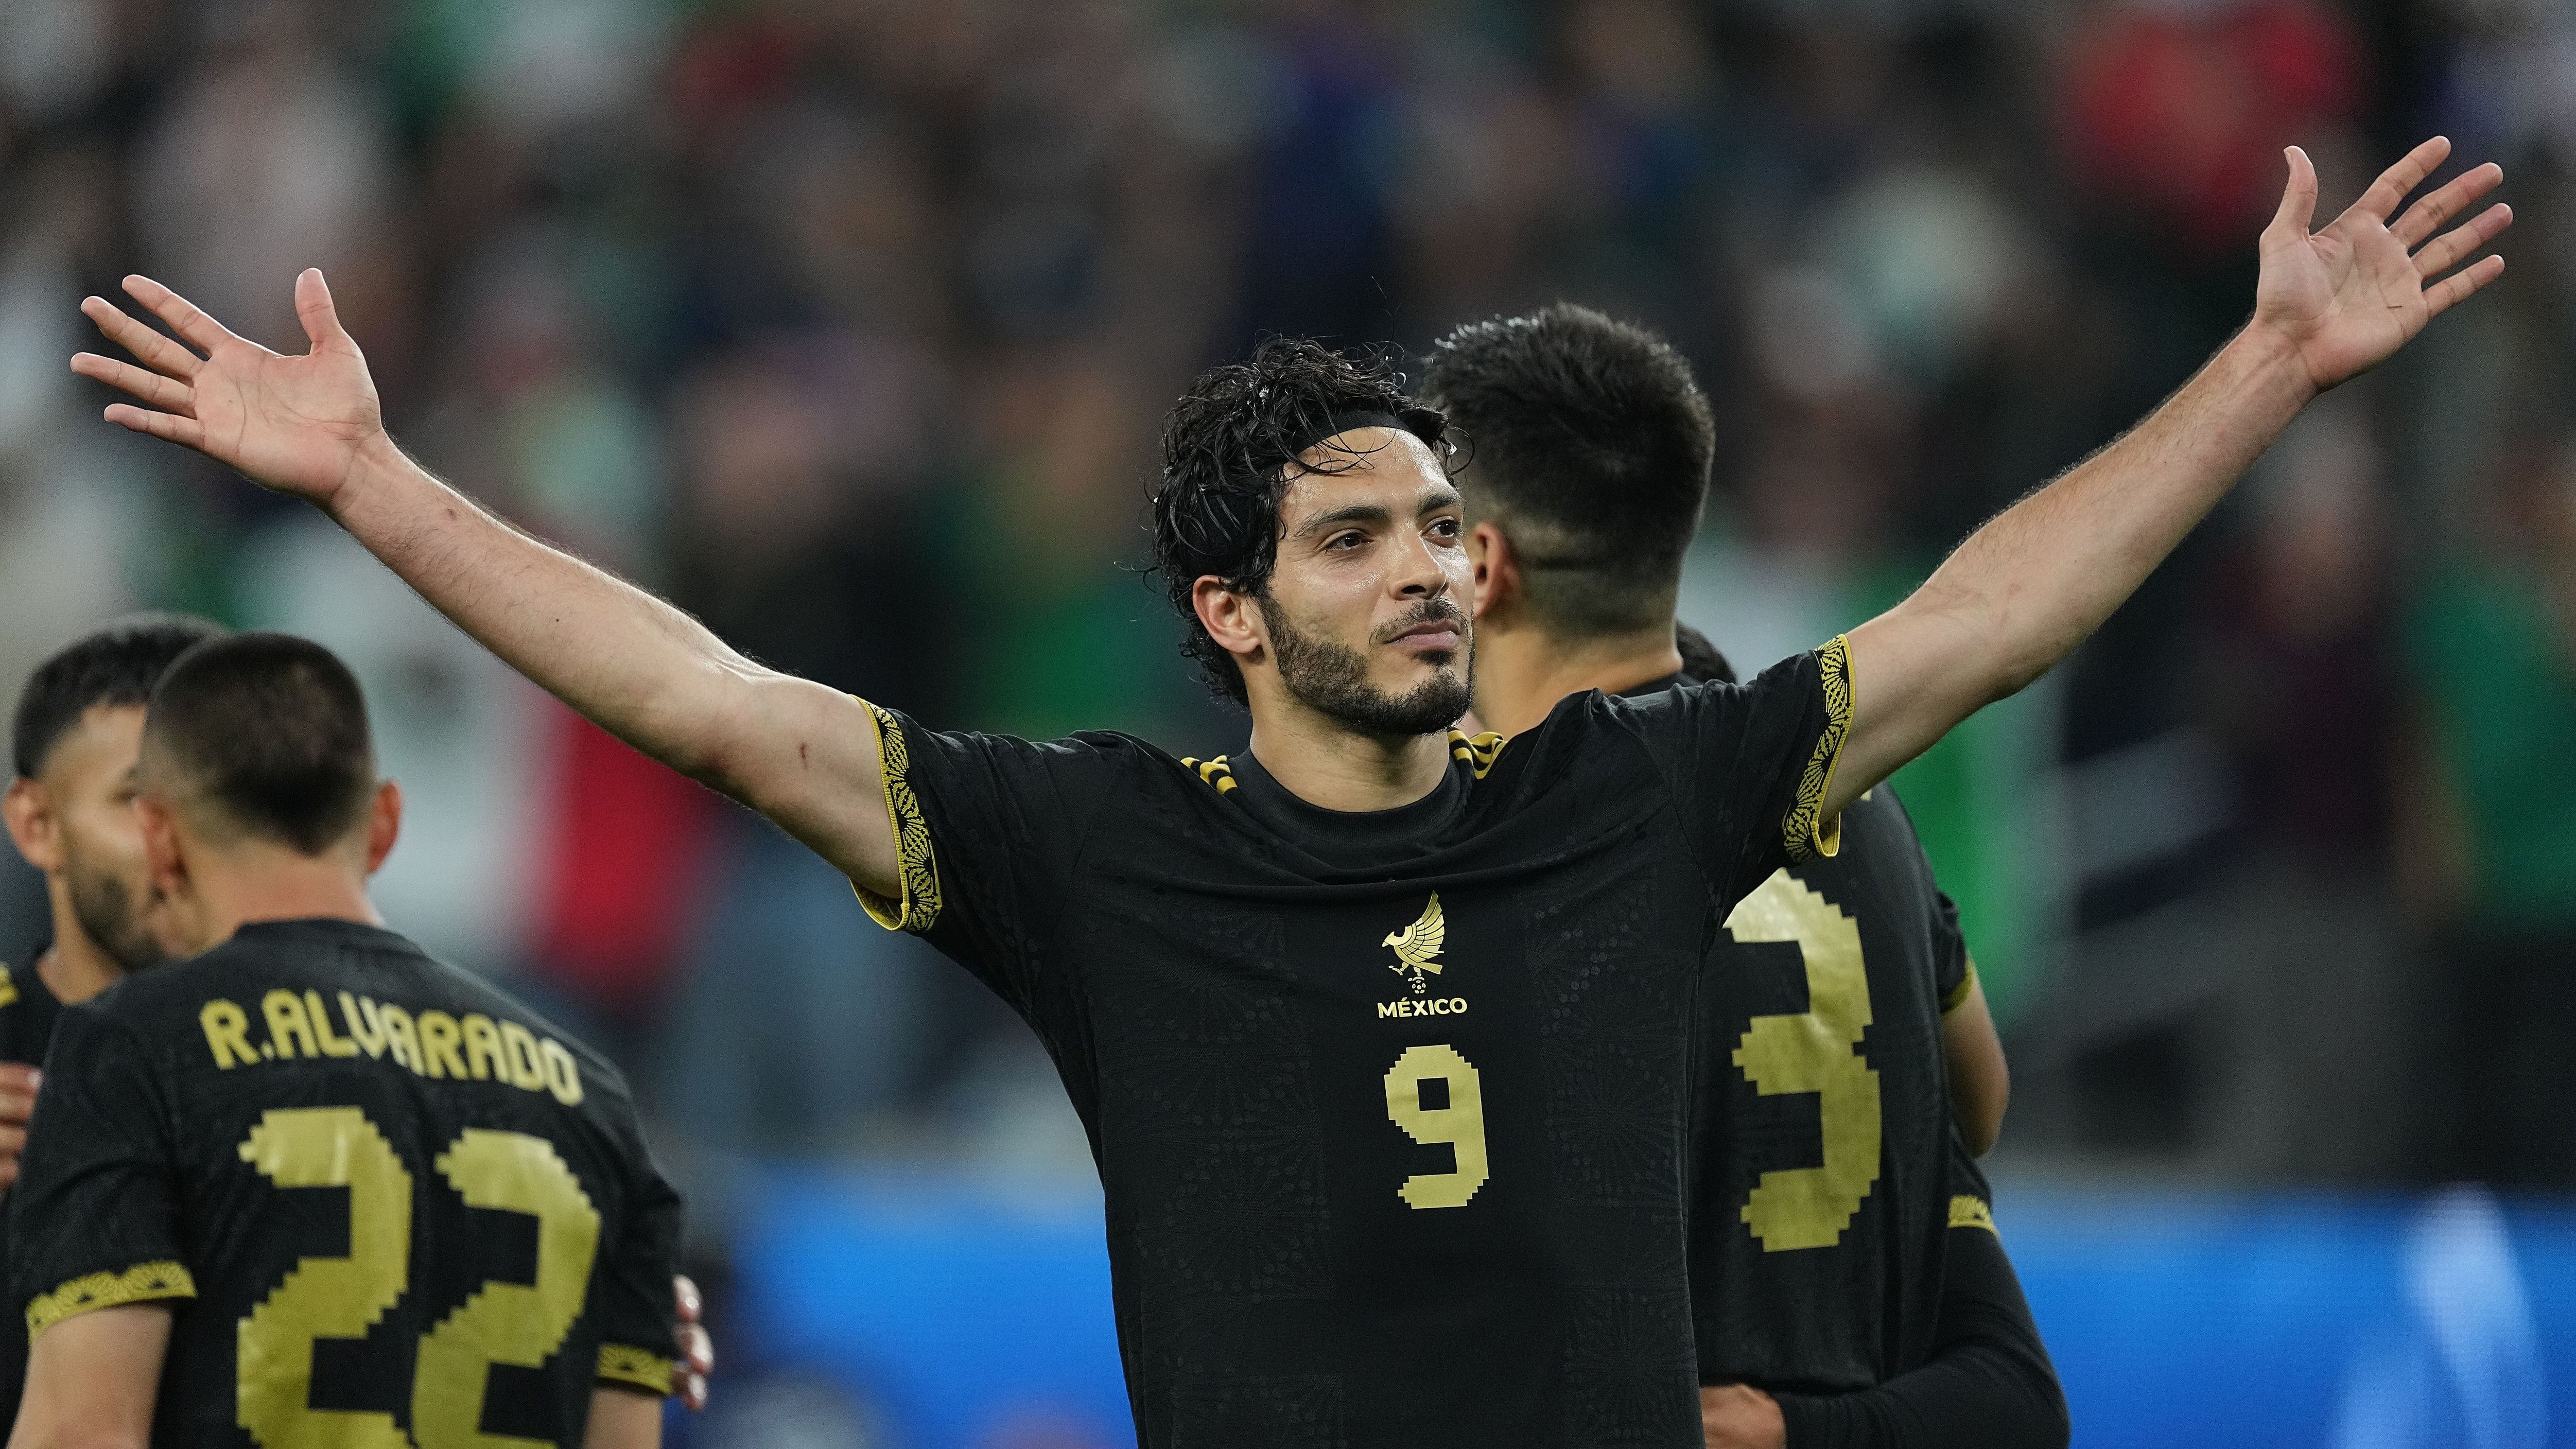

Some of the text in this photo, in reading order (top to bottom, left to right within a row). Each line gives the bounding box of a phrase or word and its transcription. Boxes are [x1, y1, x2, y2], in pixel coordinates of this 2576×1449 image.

[200, 989, 583, 1106] R.ALVARADO
[1377, 997, 1467, 1018] MÉXICO
[1722, 867, 1882, 1252] 3
[1384, 1044, 1489, 1209] 9
[236, 1106, 601, 1449] 22
